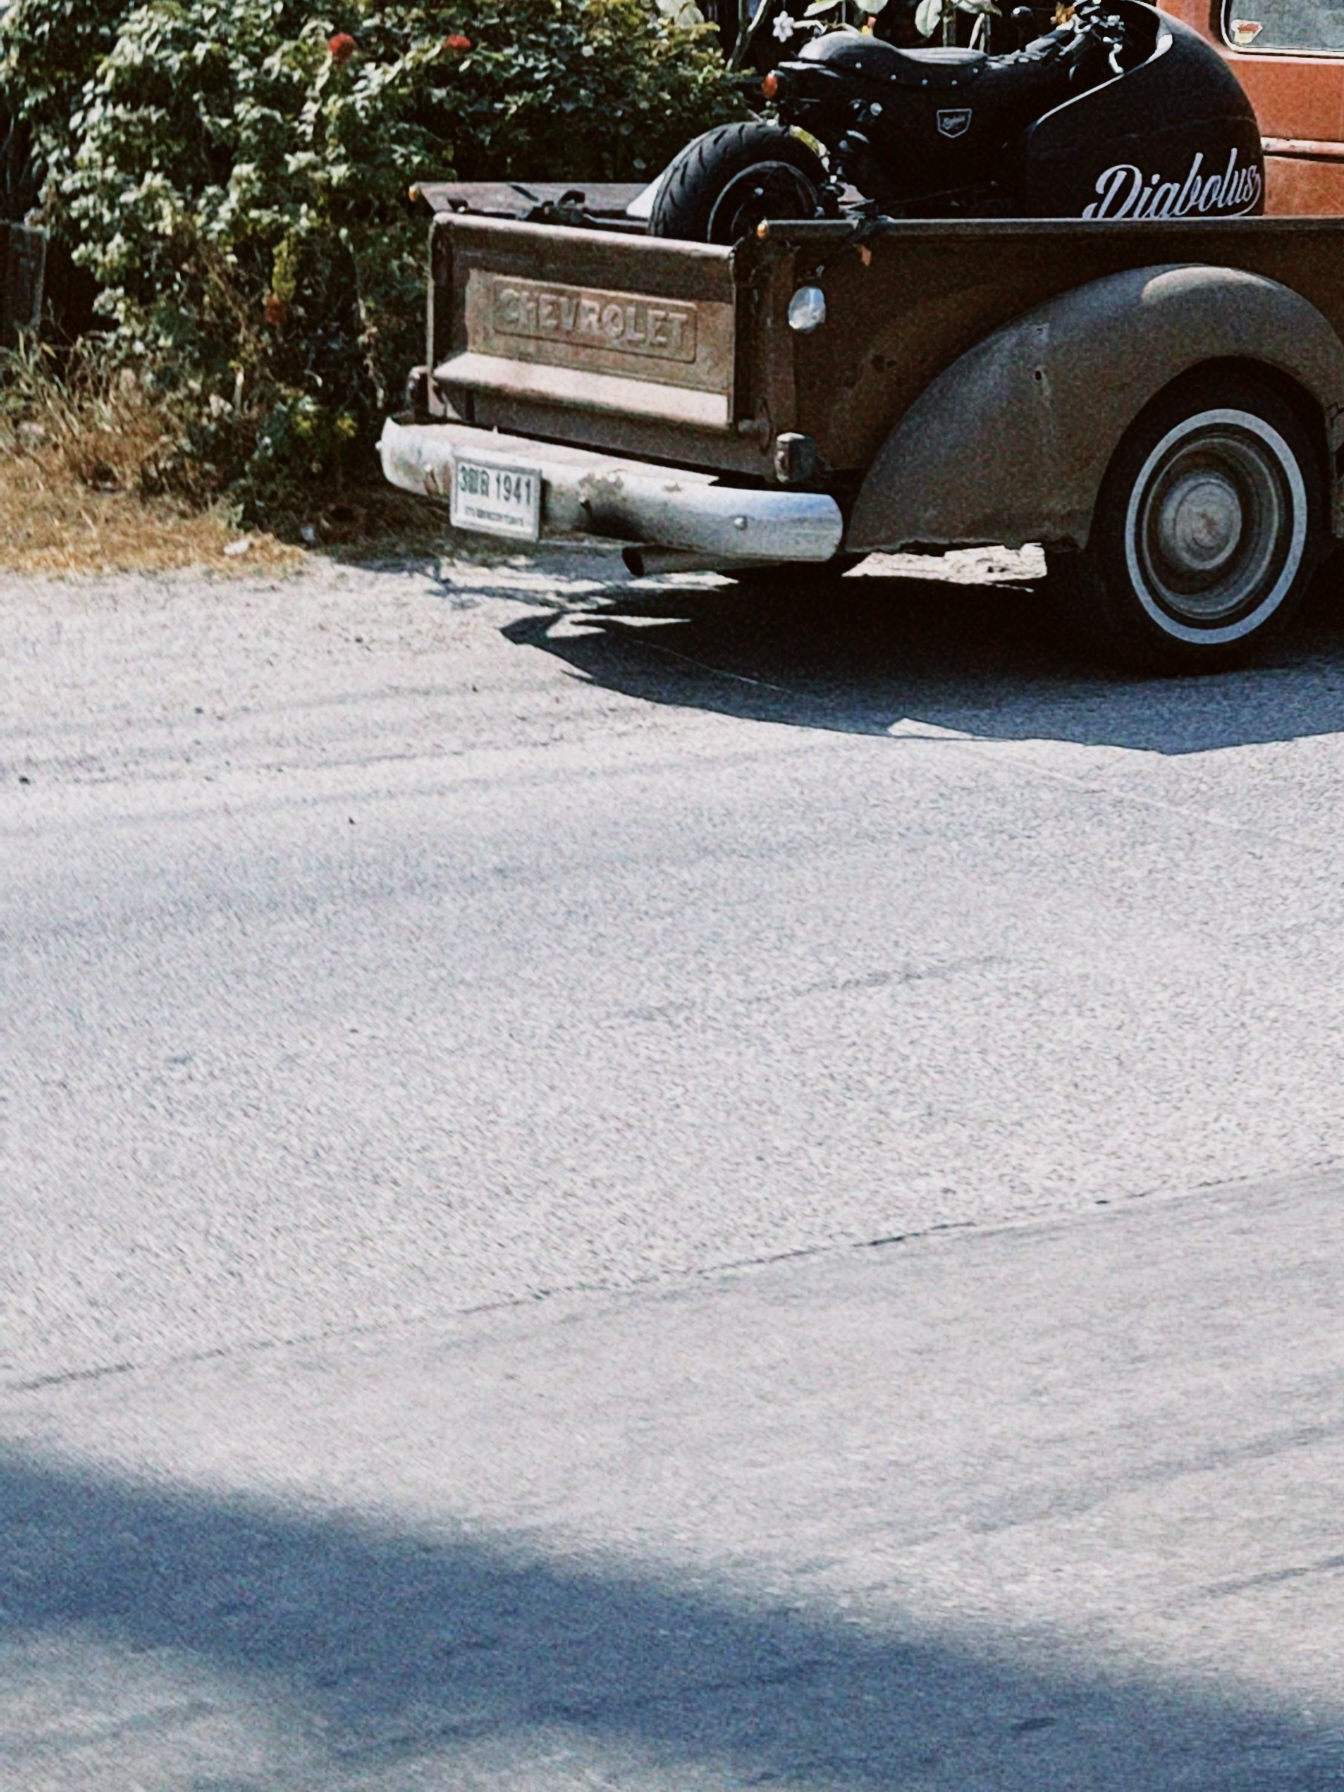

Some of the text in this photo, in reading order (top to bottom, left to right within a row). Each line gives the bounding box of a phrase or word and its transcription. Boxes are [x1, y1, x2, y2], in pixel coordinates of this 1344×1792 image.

[1082, 147, 1262, 219] Diabolus
[499, 287, 689, 350] CHEVROLET
[496, 472, 532, 506] 1941
